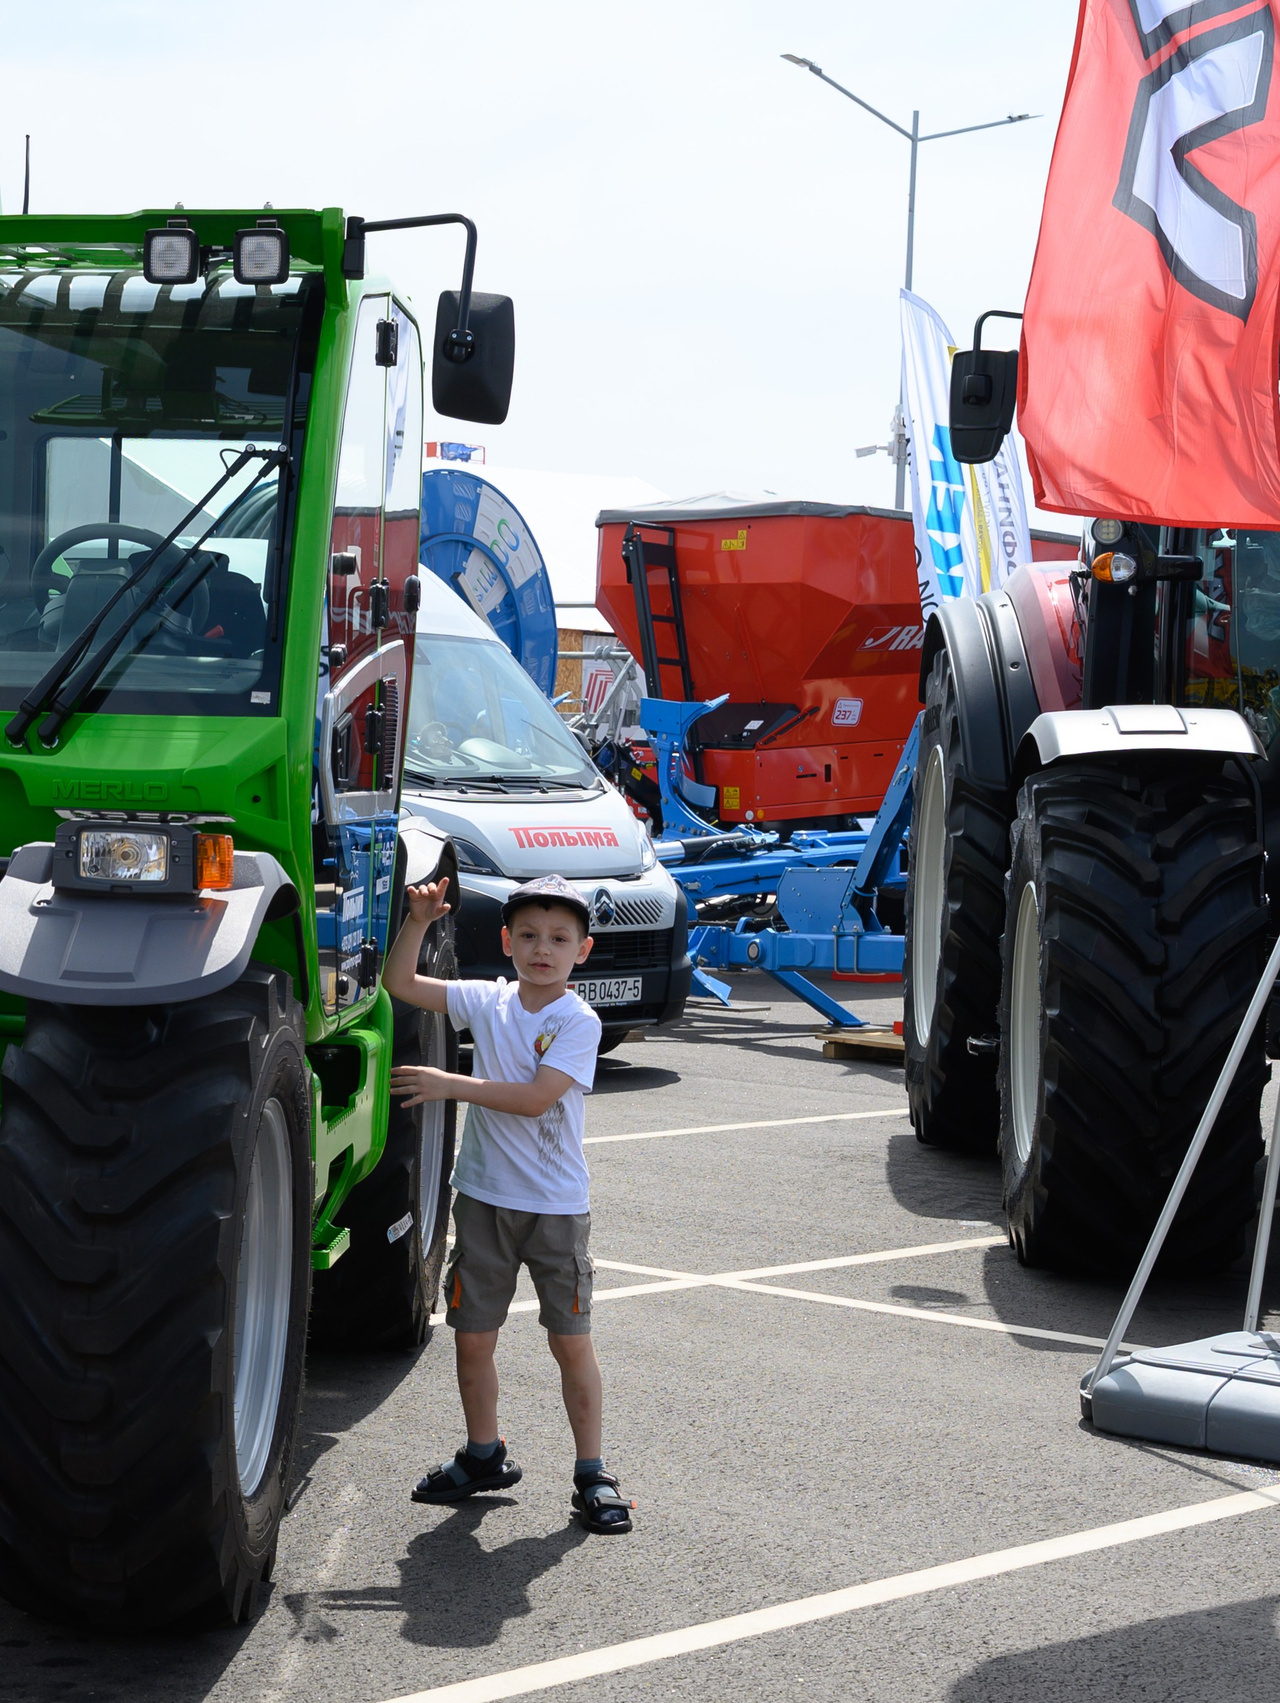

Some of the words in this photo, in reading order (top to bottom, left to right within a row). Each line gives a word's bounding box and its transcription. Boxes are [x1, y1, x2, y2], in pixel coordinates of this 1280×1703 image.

[835, 709, 852, 721] 237
[52, 779, 169, 801] MERLO
[508, 826, 619, 850] Полымя
